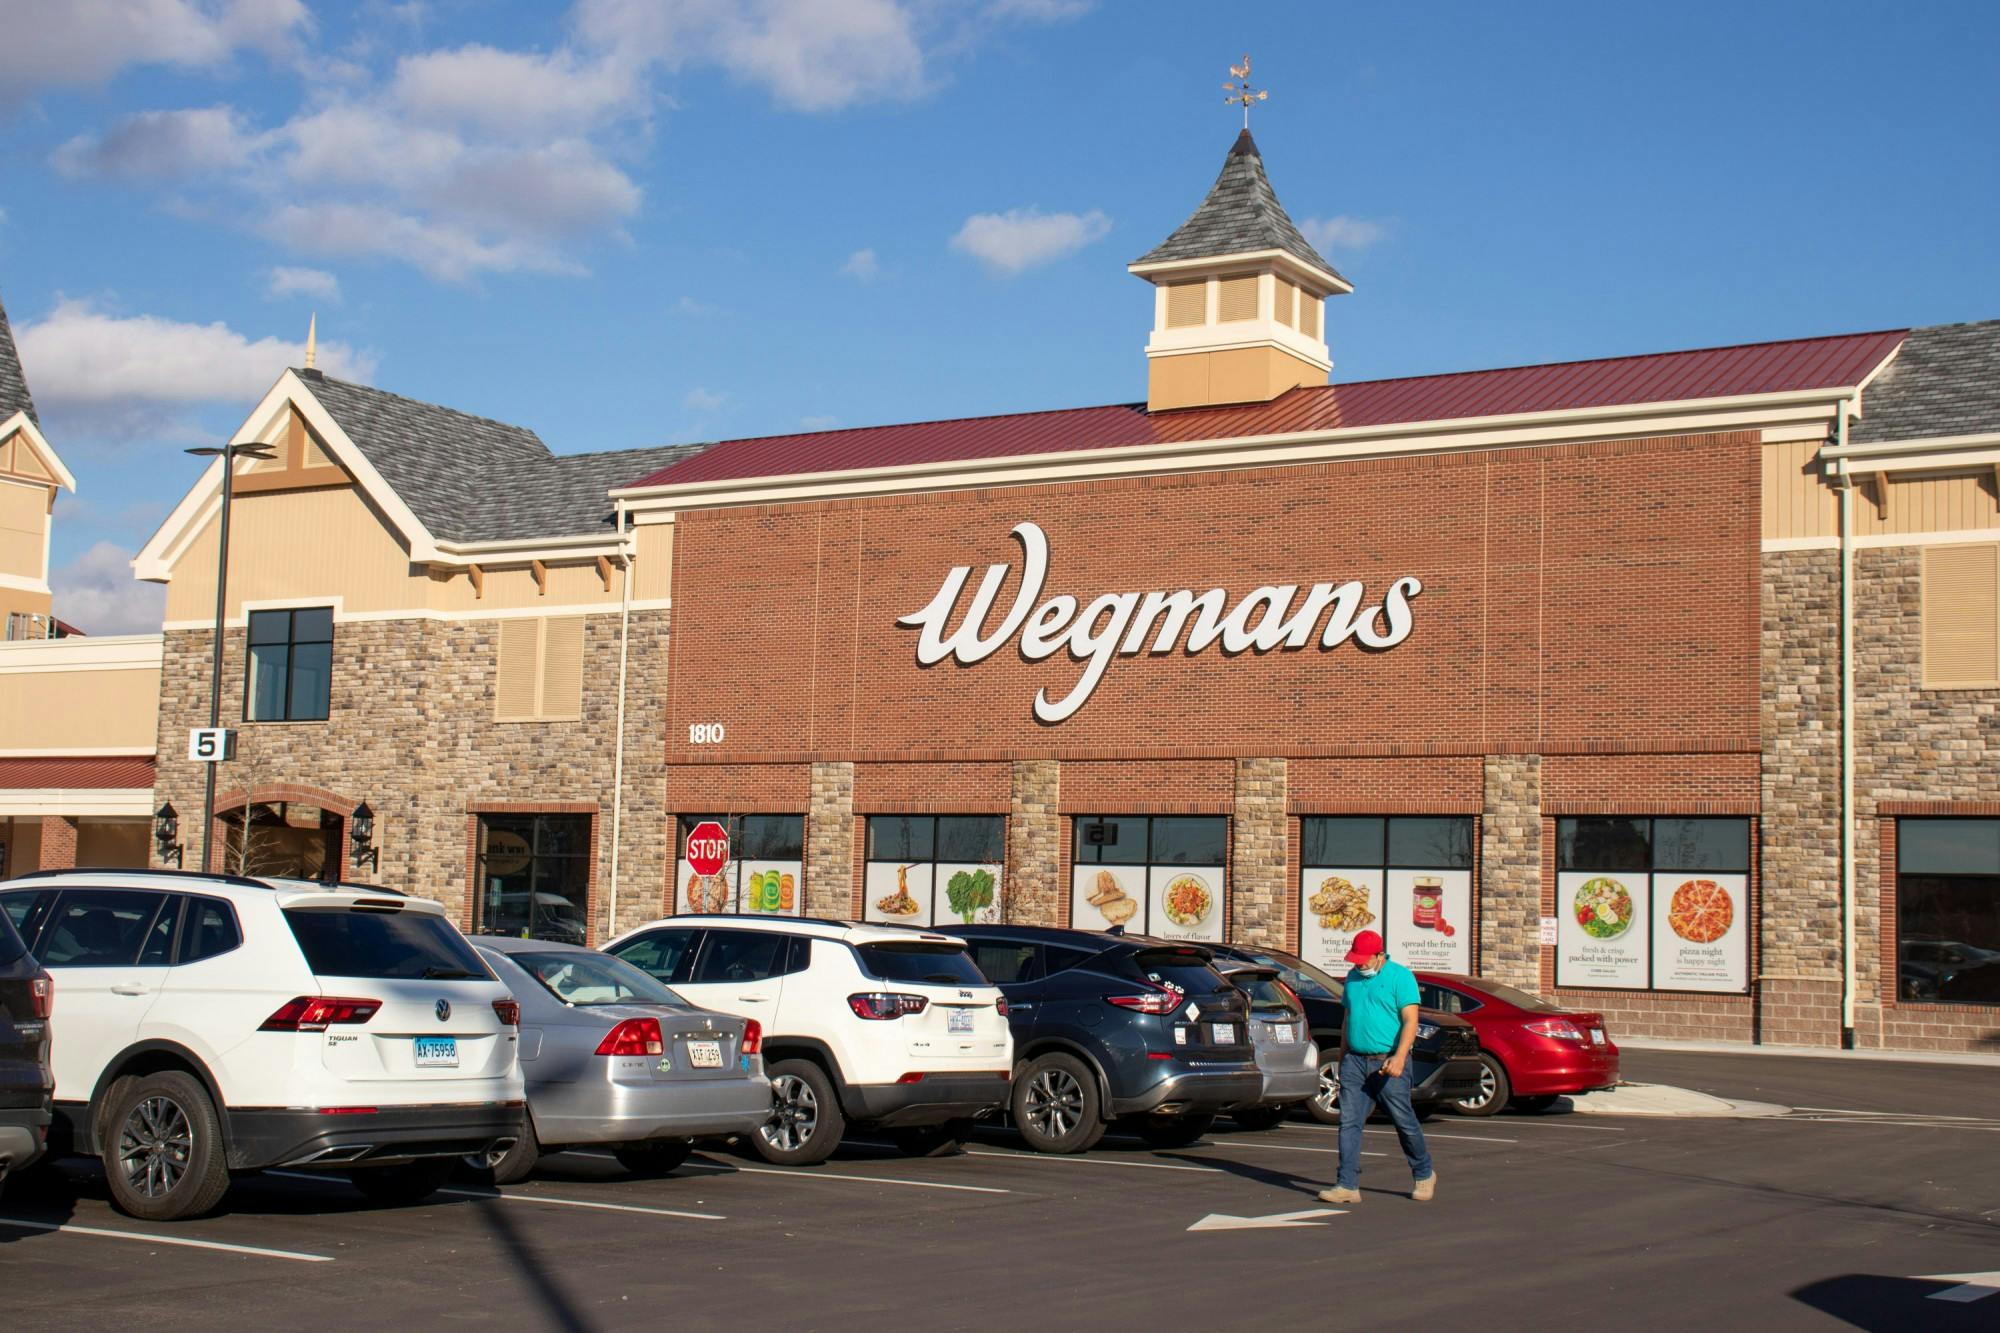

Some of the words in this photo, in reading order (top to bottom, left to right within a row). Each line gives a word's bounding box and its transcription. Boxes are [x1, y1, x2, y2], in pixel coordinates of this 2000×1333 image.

[897, 521, 1422, 722] Wegmans
[688, 723, 724, 743] 1810
[197, 732, 216, 757] 5
[689, 839, 727, 859] STOP
[1321, 937, 1341, 946] bring
[1401, 940, 1426, 949] spread
[1427, 940, 1439, 948] the
[1440, 940, 1457, 949] fruit
[1431, 950, 1450, 958] sugar
[1607, 947, 1625, 956] crisp
[1679, 948, 1700, 957] pizza
[1701, 947, 1723, 957] night
[1568, 954, 1595, 963] packed
[1596, 955, 1613, 963] with
[1614, 956, 1639, 965] power
